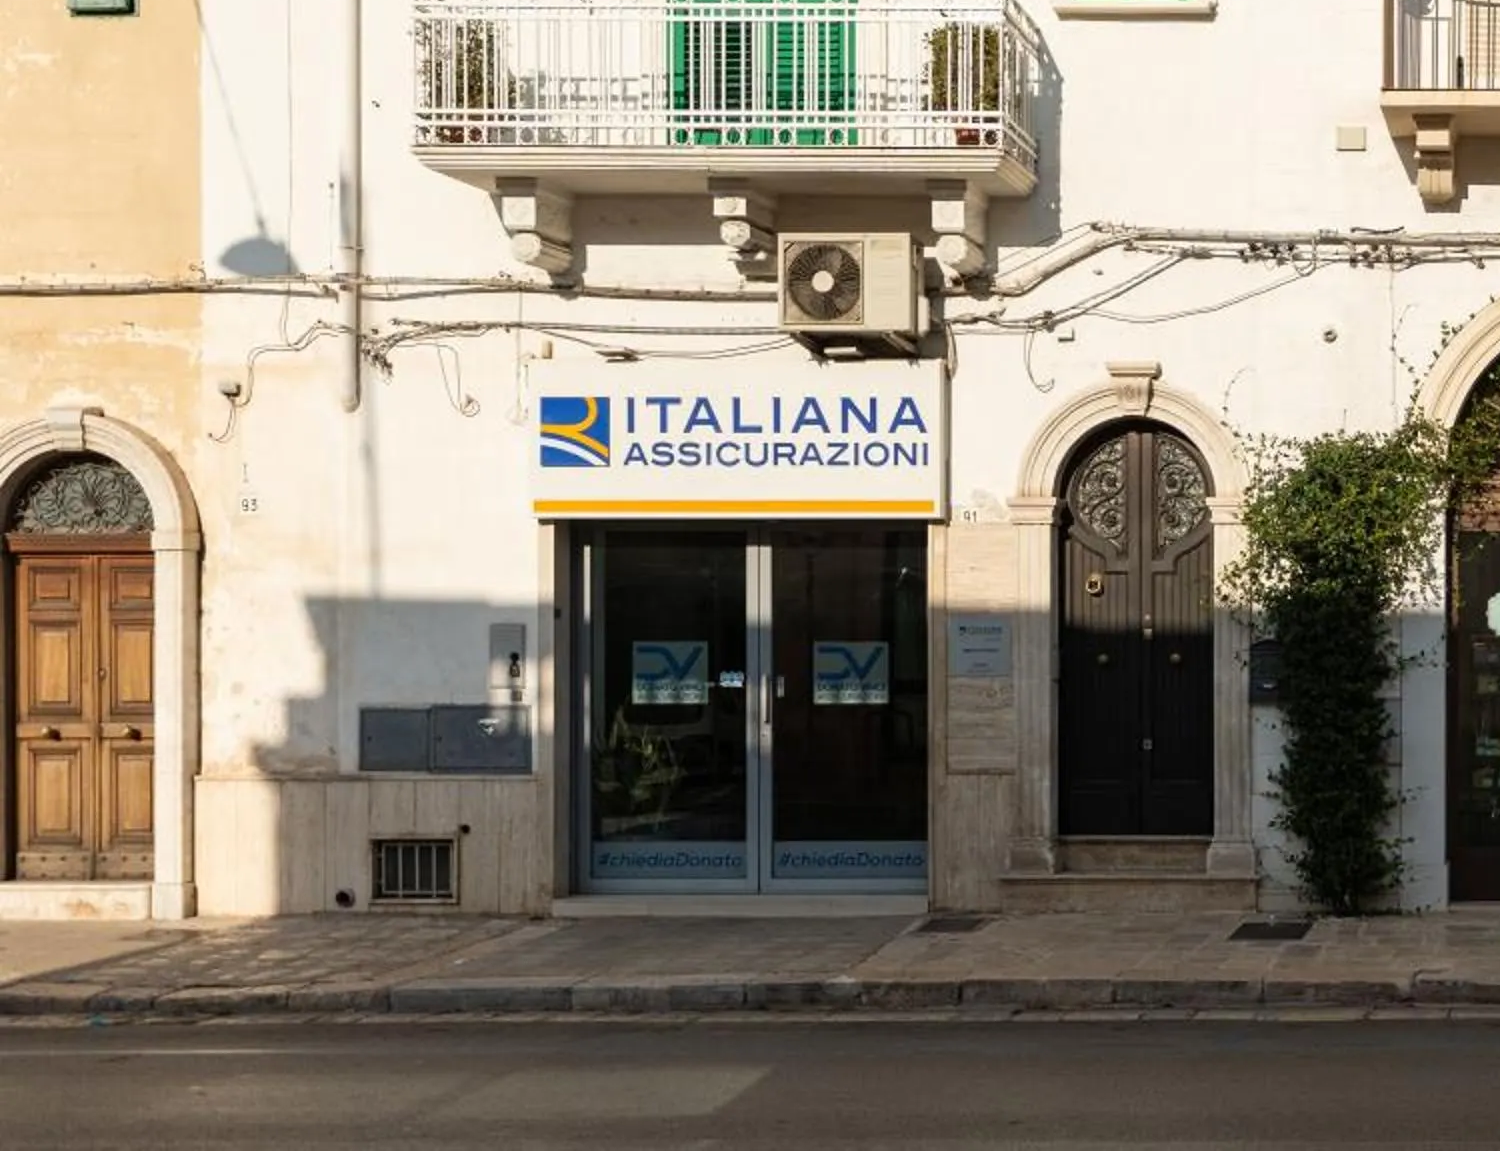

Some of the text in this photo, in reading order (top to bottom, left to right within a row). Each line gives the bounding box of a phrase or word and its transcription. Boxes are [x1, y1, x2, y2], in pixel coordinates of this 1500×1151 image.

[627, 396, 927, 434] ITALIANA
[624, 442, 929, 467] ASSICURAZIONI
[241, 498, 258, 512] 93
[963, 510, 977, 524] 91
[598, 851, 742, 867] #chiediaDonato
[777, 851, 925, 867] #chiediaDonato
